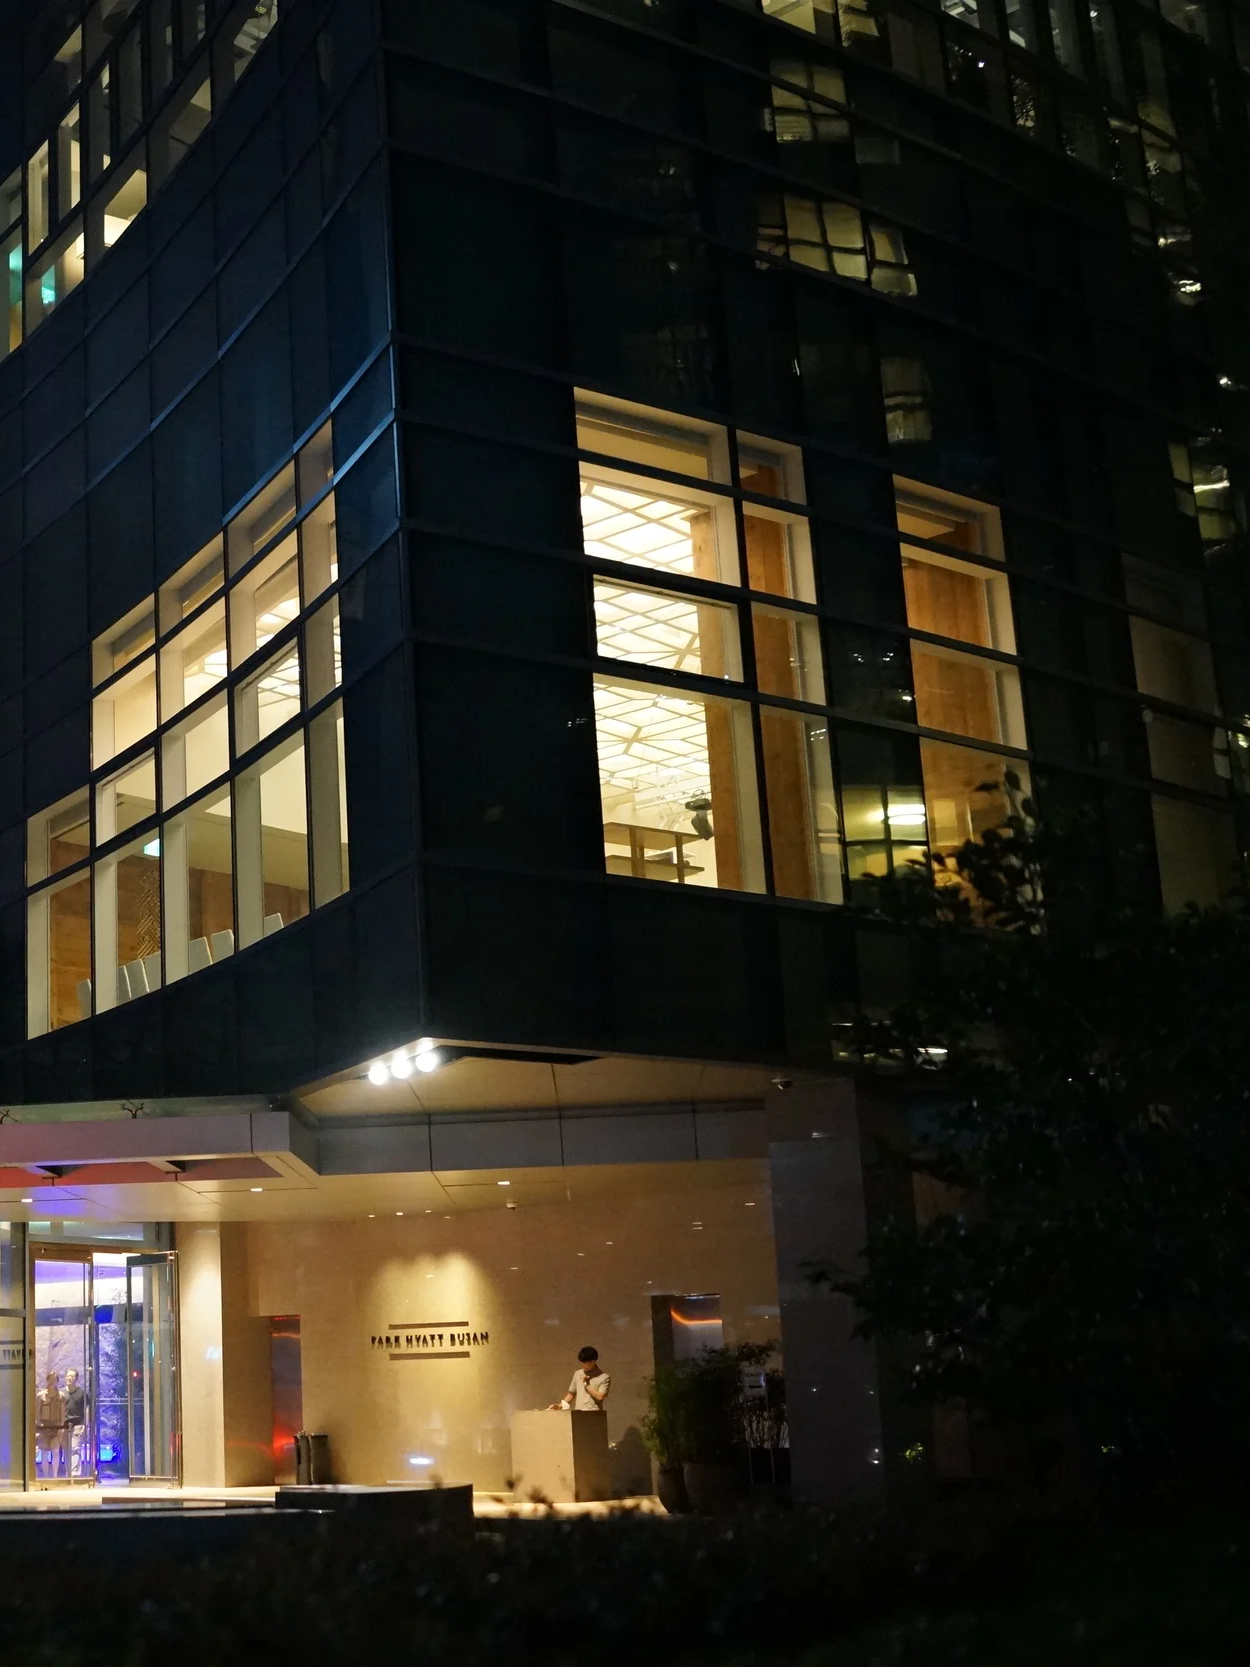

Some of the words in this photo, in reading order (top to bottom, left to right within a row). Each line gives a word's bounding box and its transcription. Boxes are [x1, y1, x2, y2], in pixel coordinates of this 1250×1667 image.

[371, 1335, 401, 1347] PARK
[406, 1334, 444, 1347] HYATT
[450, 1331, 489, 1346] BUSAN
